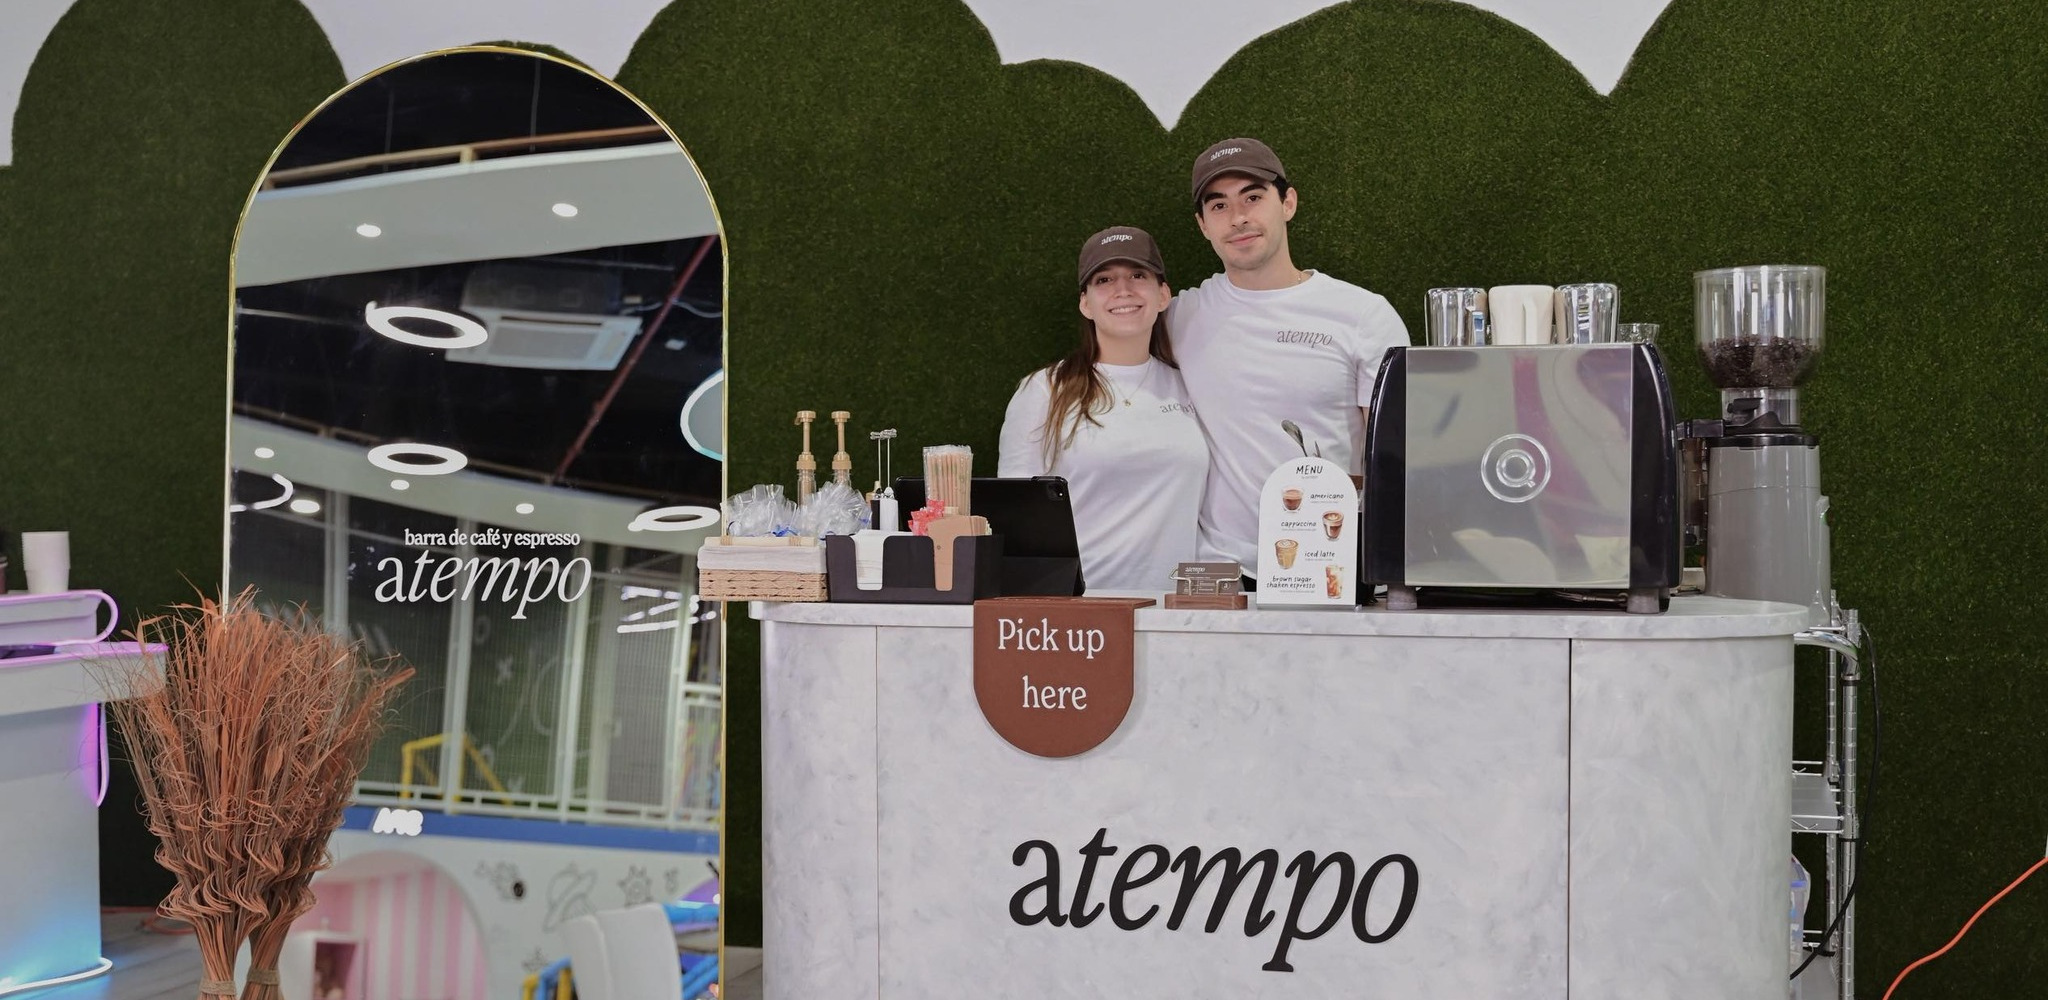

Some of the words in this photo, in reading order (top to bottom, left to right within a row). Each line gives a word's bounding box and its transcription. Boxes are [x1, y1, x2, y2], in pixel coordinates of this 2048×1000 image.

[1210, 147, 1242, 161] atempo
[1101, 234, 1133, 245] atempo
[1276, 330, 1333, 349] atempo
[1296, 464, 1323, 475] MENU
[404, 528, 447, 545] barra
[448, 528, 467, 545] de
[469, 528, 500, 546] café
[502, 533, 512, 549] y
[514, 533, 580, 549] espresso
[374, 550, 592, 619] atempo
[998, 617, 1059, 651] Pick
[1066, 628, 1105, 659] up
[1022, 675, 1087, 710] here
[1009, 827, 1419, 972] atempo
